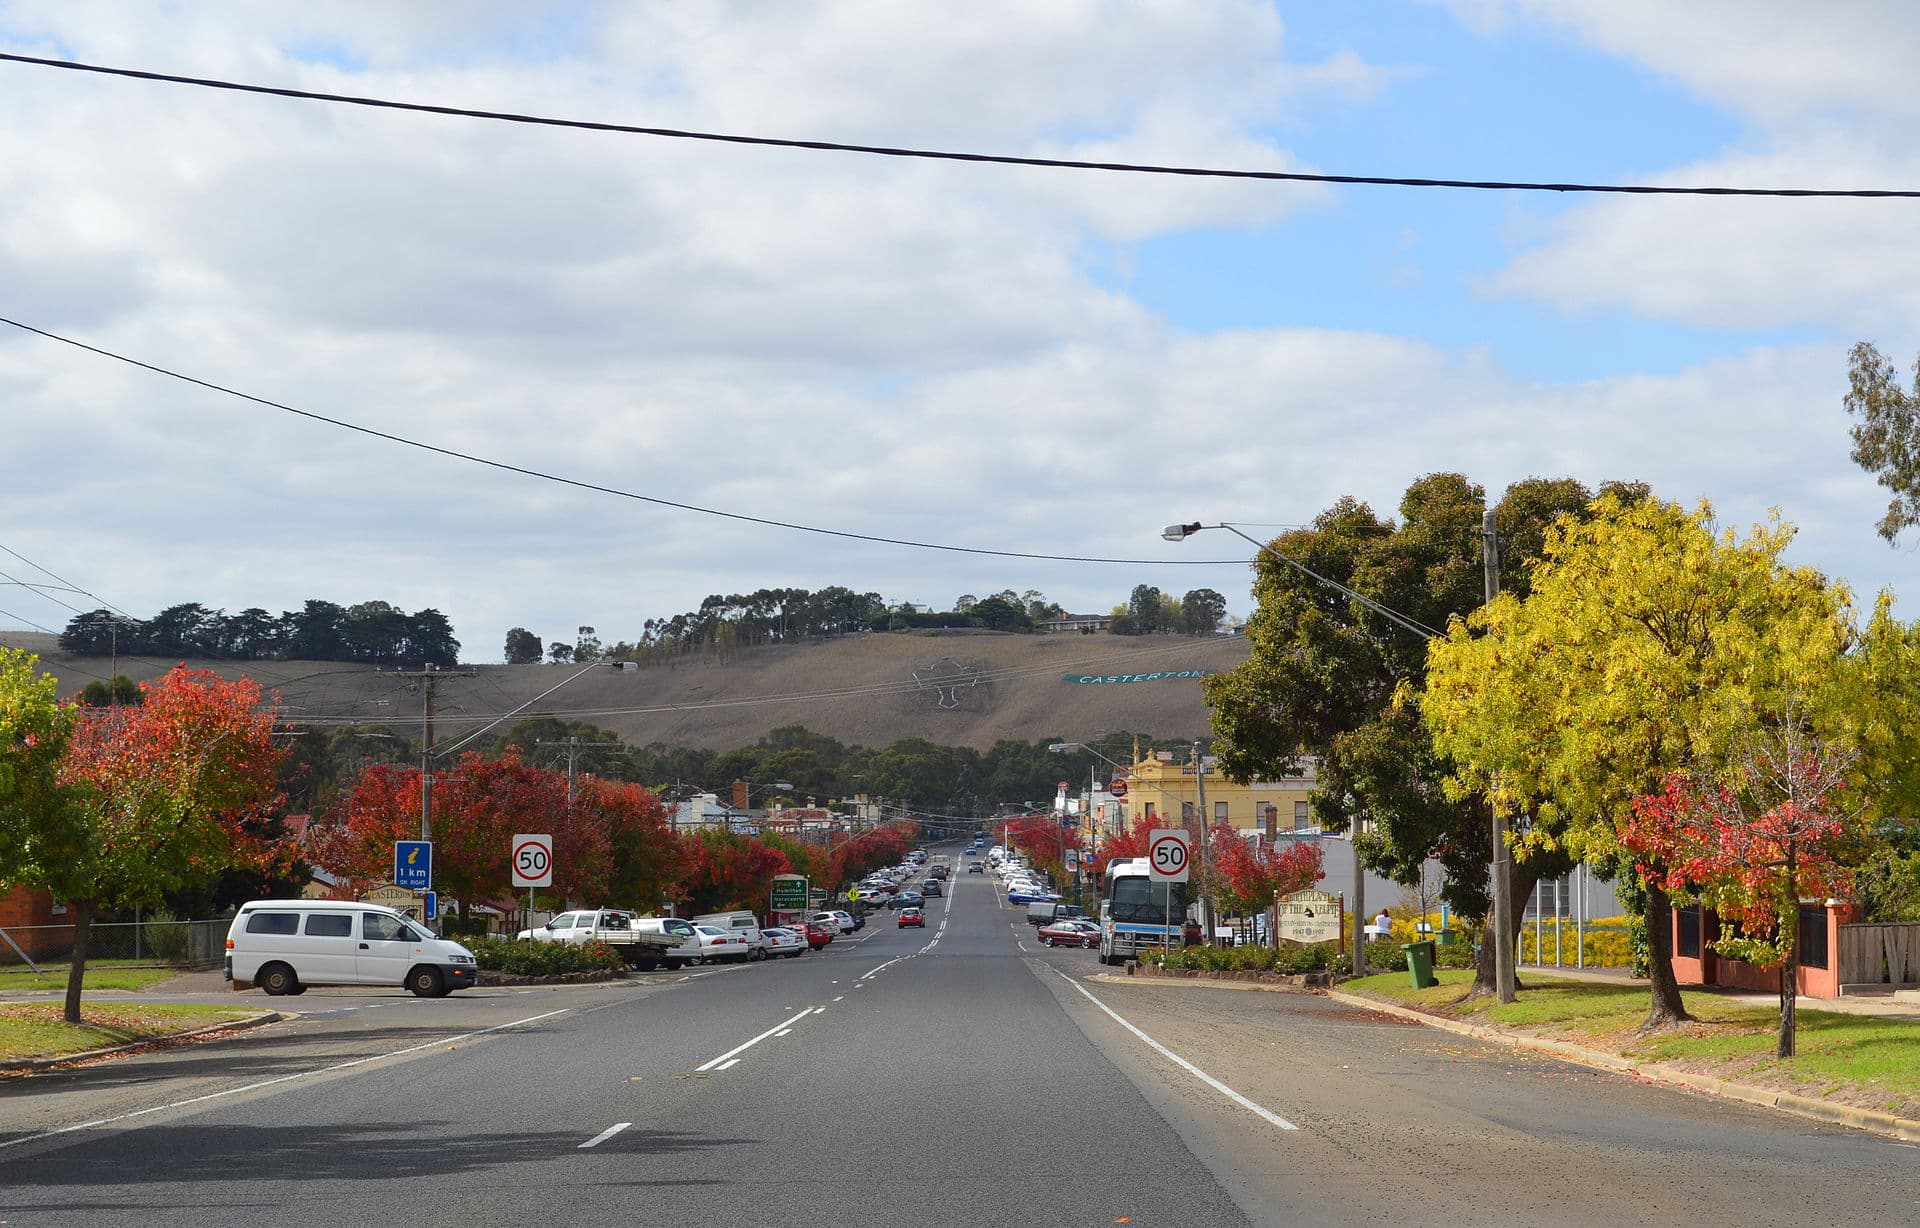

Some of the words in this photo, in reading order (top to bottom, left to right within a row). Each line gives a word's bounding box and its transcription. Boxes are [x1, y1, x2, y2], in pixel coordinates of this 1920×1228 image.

[1079, 671, 1204, 684] CASTERTON
[520, 852, 546, 870] 50
[1157, 846, 1183, 865] 50
[399, 867, 404, 876] 1
[408, 868, 426, 877] km
[371, 888, 411, 900] CASTERTON
[1289, 891, 1328, 902] BIRTHPLACE
[1315, 904, 1339, 918] KELPIE
